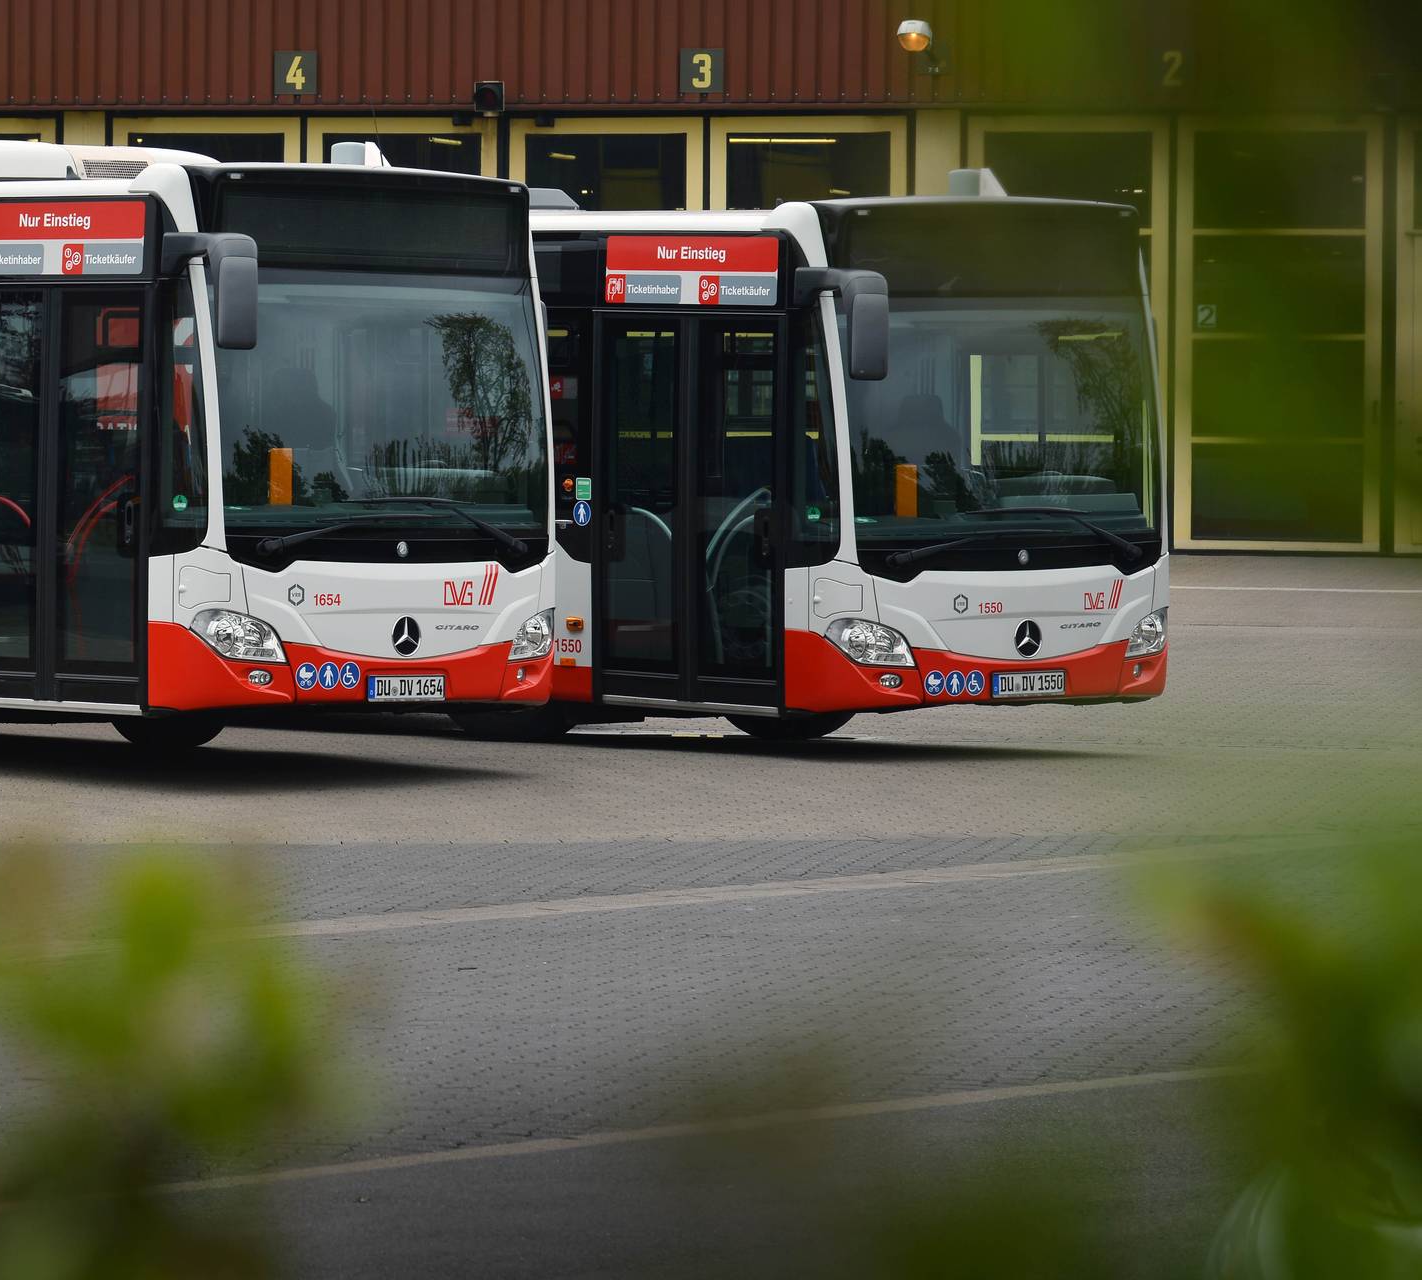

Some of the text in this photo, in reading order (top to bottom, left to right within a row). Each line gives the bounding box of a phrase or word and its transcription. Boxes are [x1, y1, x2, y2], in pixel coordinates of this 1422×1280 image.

[286, 56, 305, 90] 4
[692, 53, 712, 88] 3
[1162, 51, 1182, 86] 2
[19, 213, 91, 230] Nur Einstieg
[85, 253, 136, 265] Ticketkäufer
[657, 246, 726, 262] Nur Einstieg
[627, 284, 679, 295] Ticketinhaber
[720, 285, 771, 296] Ticketkäufer
[1200, 306, 1214, 325] 2
[314, 594, 341, 606] 1654
[444, 581, 472, 605] DVG
[1084, 592, 1104, 610] DVG
[978, 602, 1003, 613] 1550
[1060, 621, 1101, 630] CITARO
[555, 638, 582, 653] 1550
[377, 679, 391, 696] DU
[399, 679, 414, 696] DV
[416, 678, 443, 696] 1654
[1000, 676, 1014, 692] DU
[1022, 675, 1036, 692] DV
[1038, 674, 1063, 691] 1550
